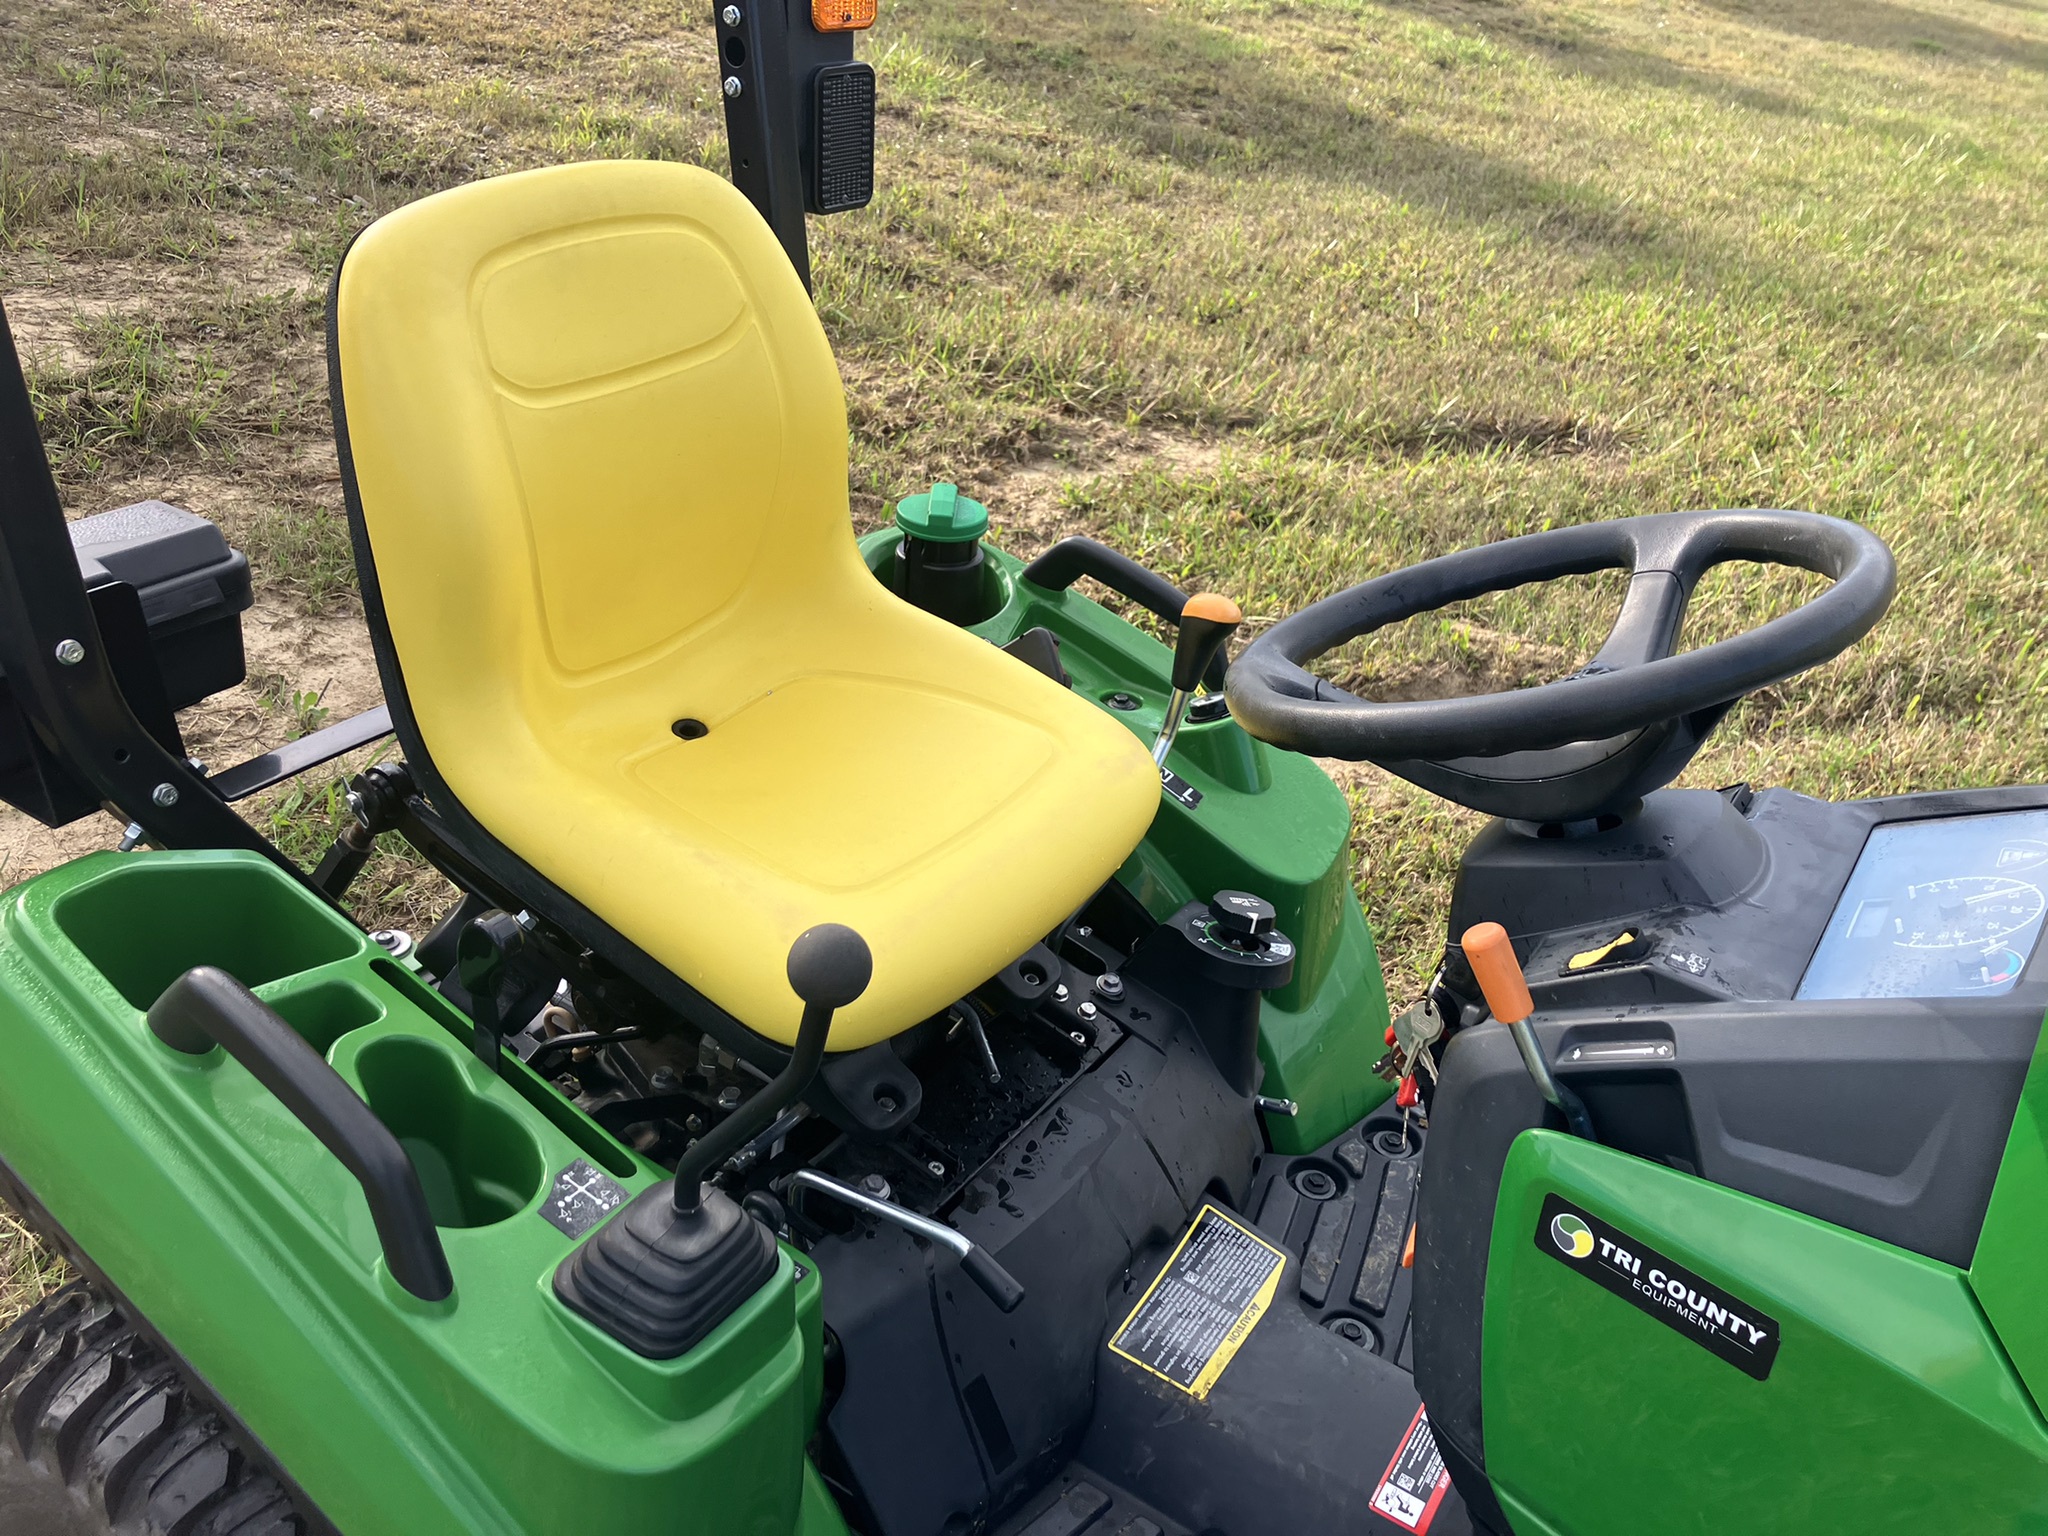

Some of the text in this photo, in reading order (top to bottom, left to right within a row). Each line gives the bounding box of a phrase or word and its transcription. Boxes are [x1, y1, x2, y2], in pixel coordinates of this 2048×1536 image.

[1182, 788, 1193, 801] L
[1599, 1237, 1767, 1346] TRI COUNTY
[1632, 1278, 1719, 1335] EQUIPMENT
[1226, 1308, 1257, 1344] CAUTION
